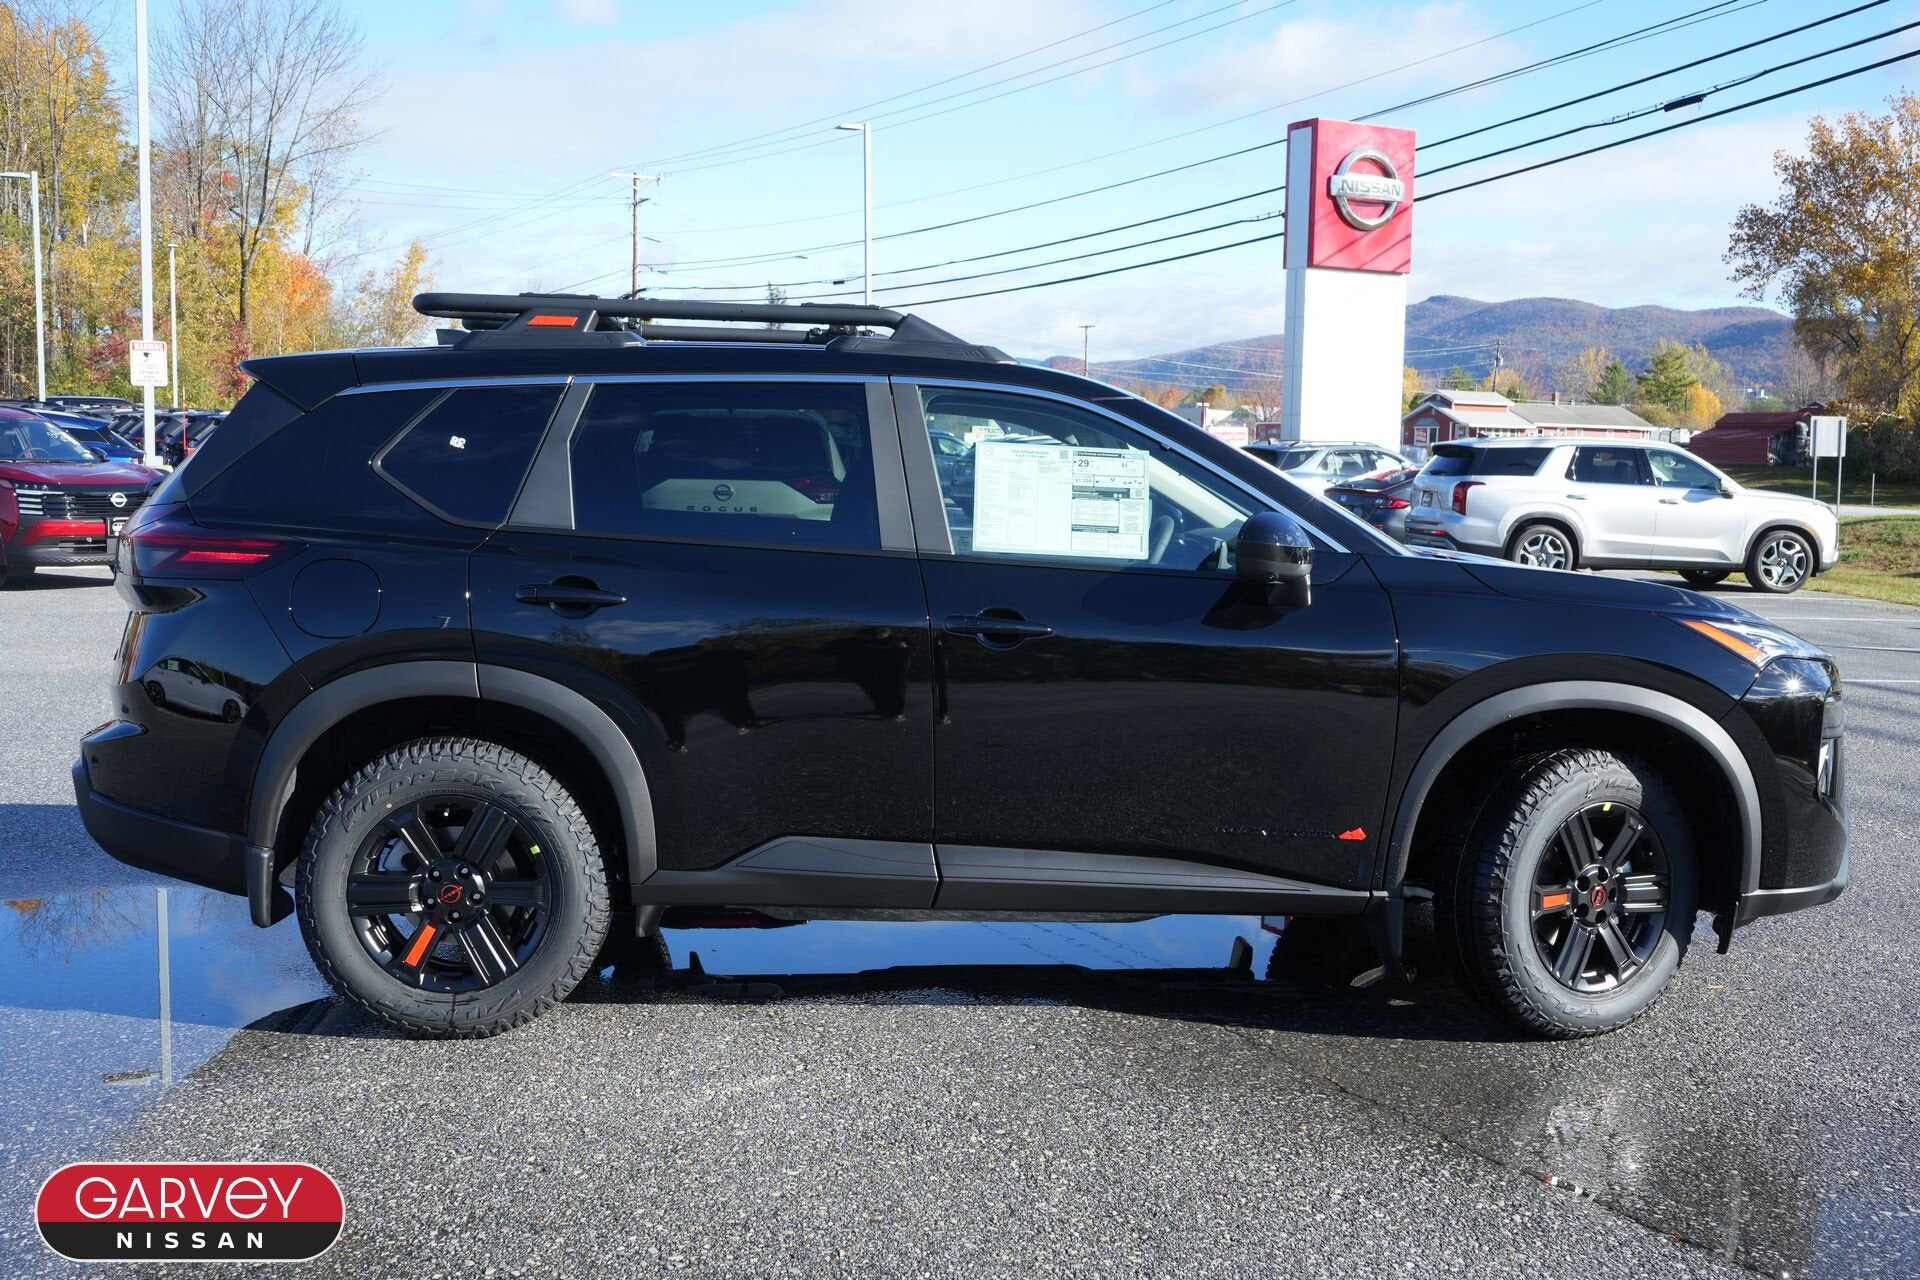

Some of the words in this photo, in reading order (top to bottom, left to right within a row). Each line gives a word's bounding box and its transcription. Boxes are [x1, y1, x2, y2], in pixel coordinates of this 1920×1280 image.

[1341, 179, 1401, 197] NISSAN
[1078, 459, 1089, 467] 29
[686, 505, 758, 513] ROGUE
